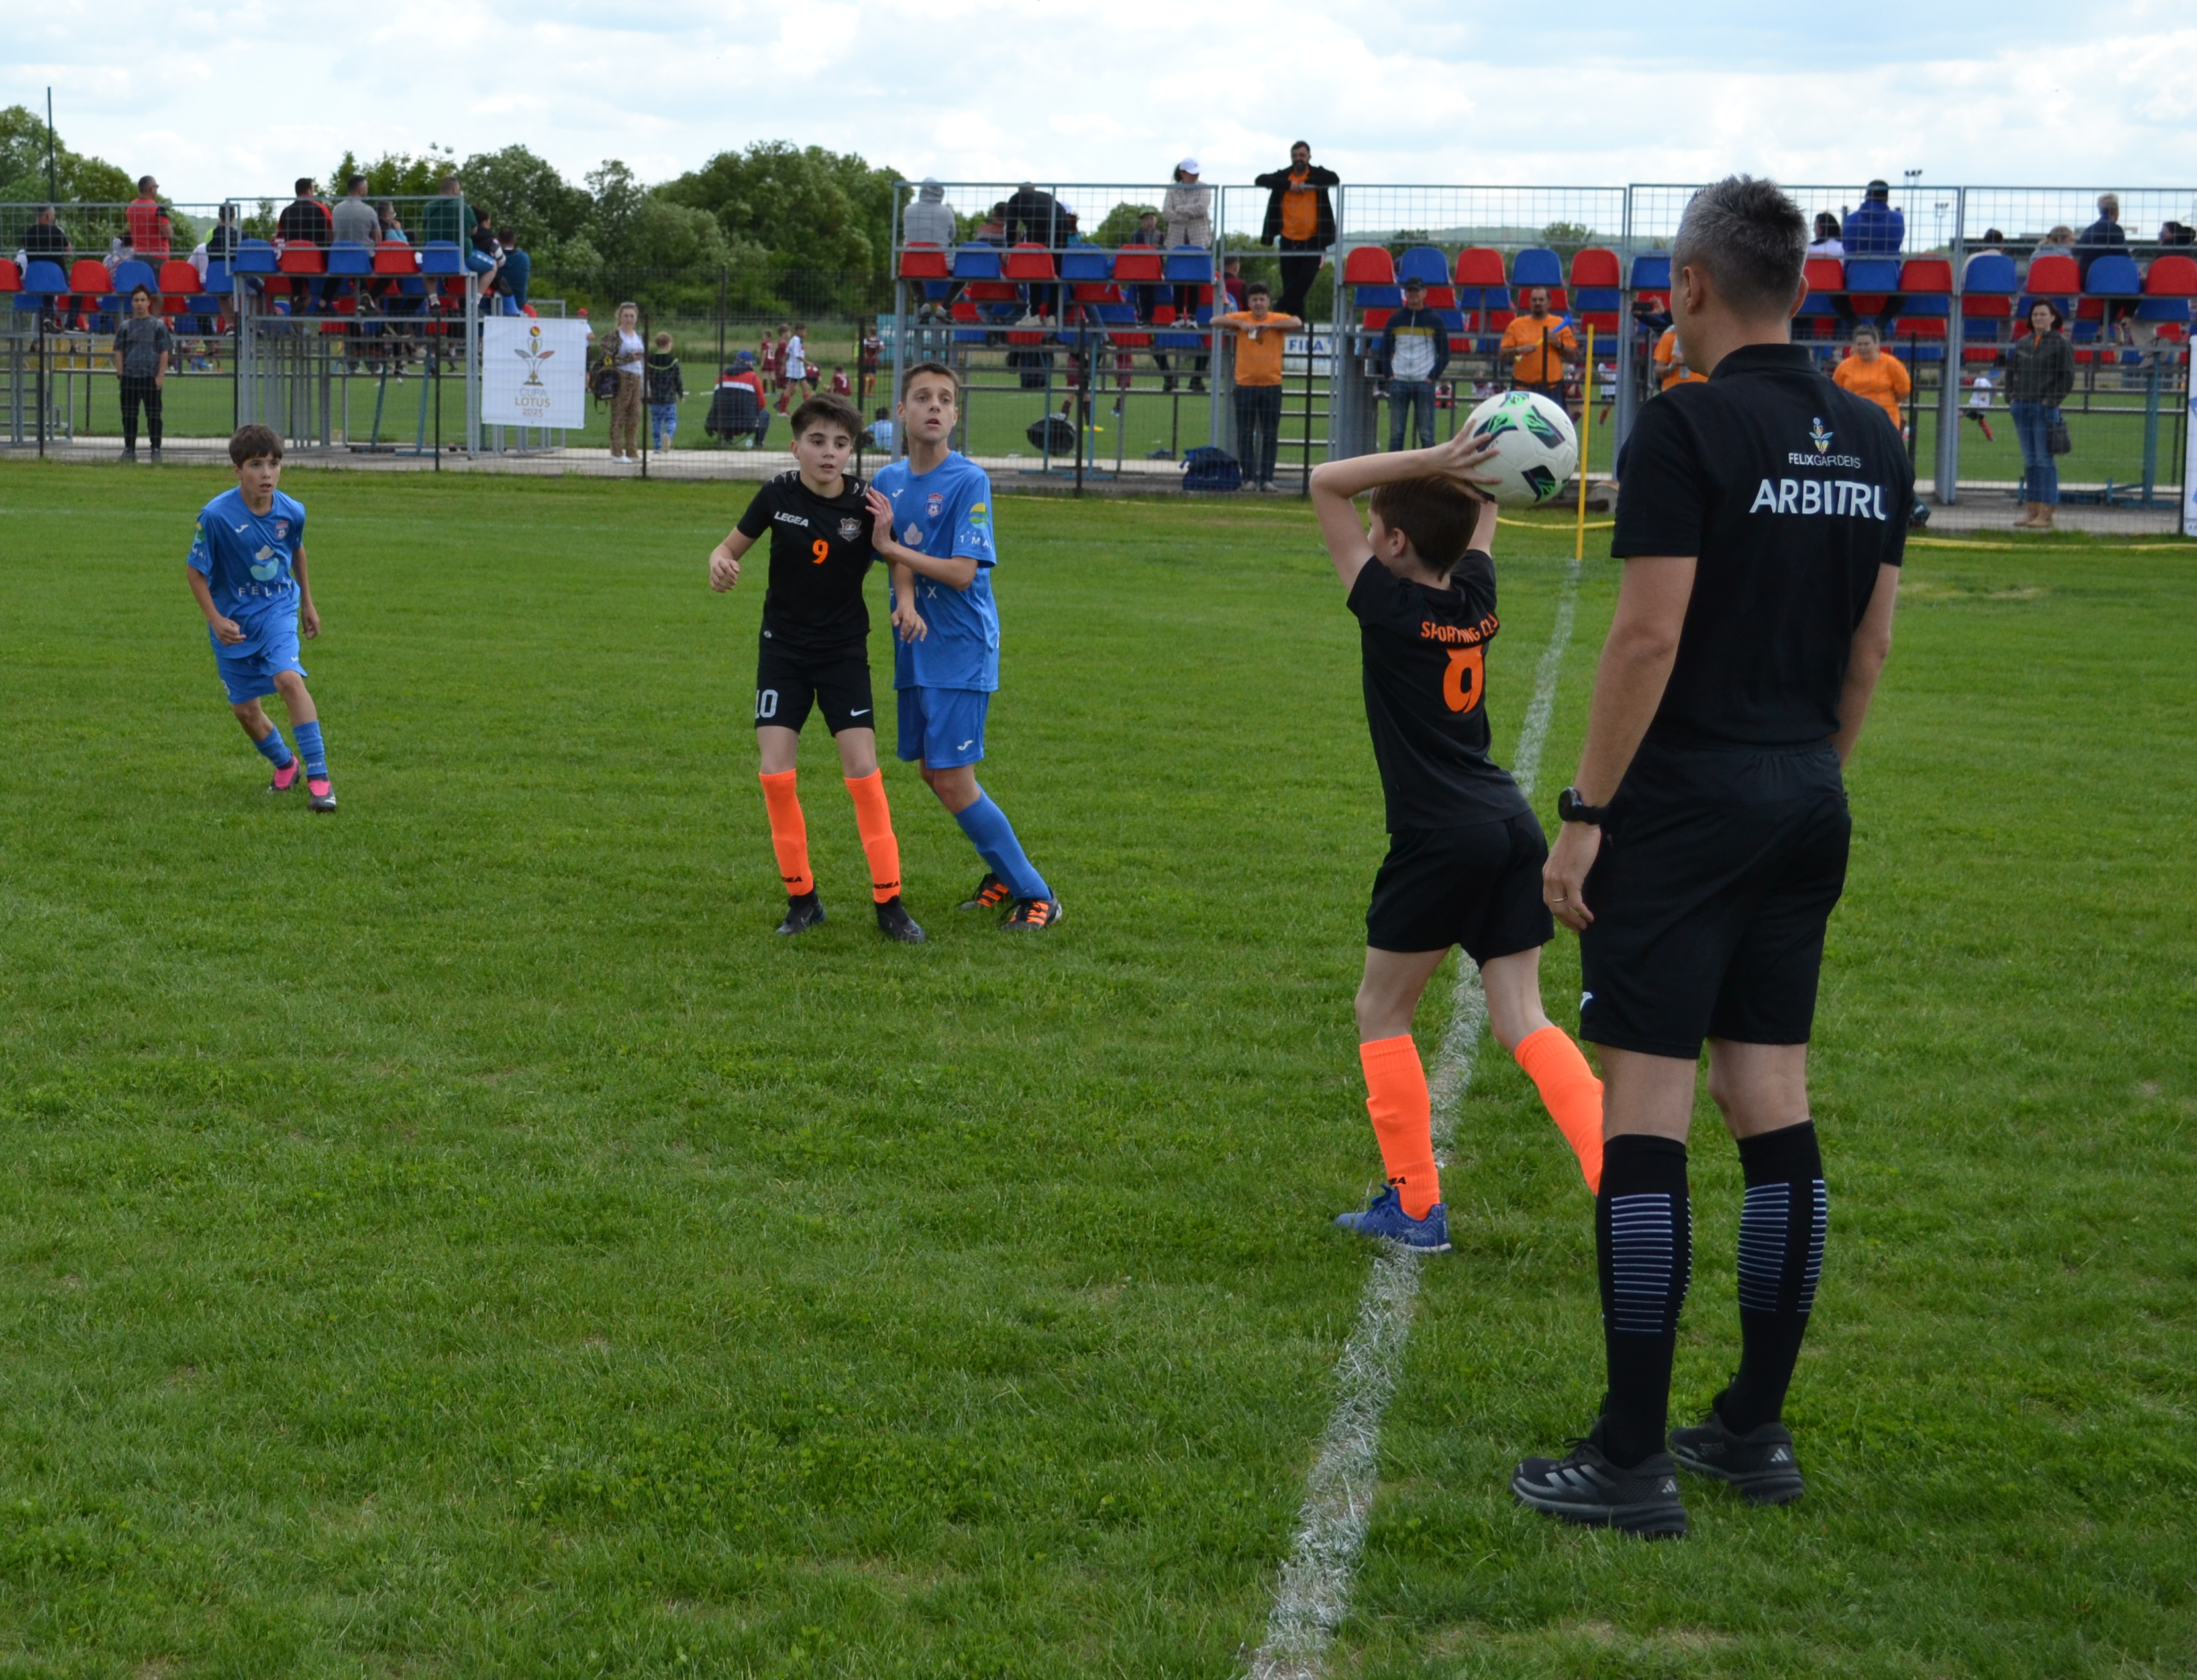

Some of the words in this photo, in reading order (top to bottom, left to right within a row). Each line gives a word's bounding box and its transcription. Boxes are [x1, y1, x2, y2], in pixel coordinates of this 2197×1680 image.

[519, 387, 548, 397] CUPA
[515, 397, 551, 409] LOTUS
[522, 407, 543, 418] 2025
[774, 511, 809, 528] LEGEA
[960, 534, 965, 544] 1
[812, 538, 829, 565] 9
[889, 585, 937, 601] FIX
